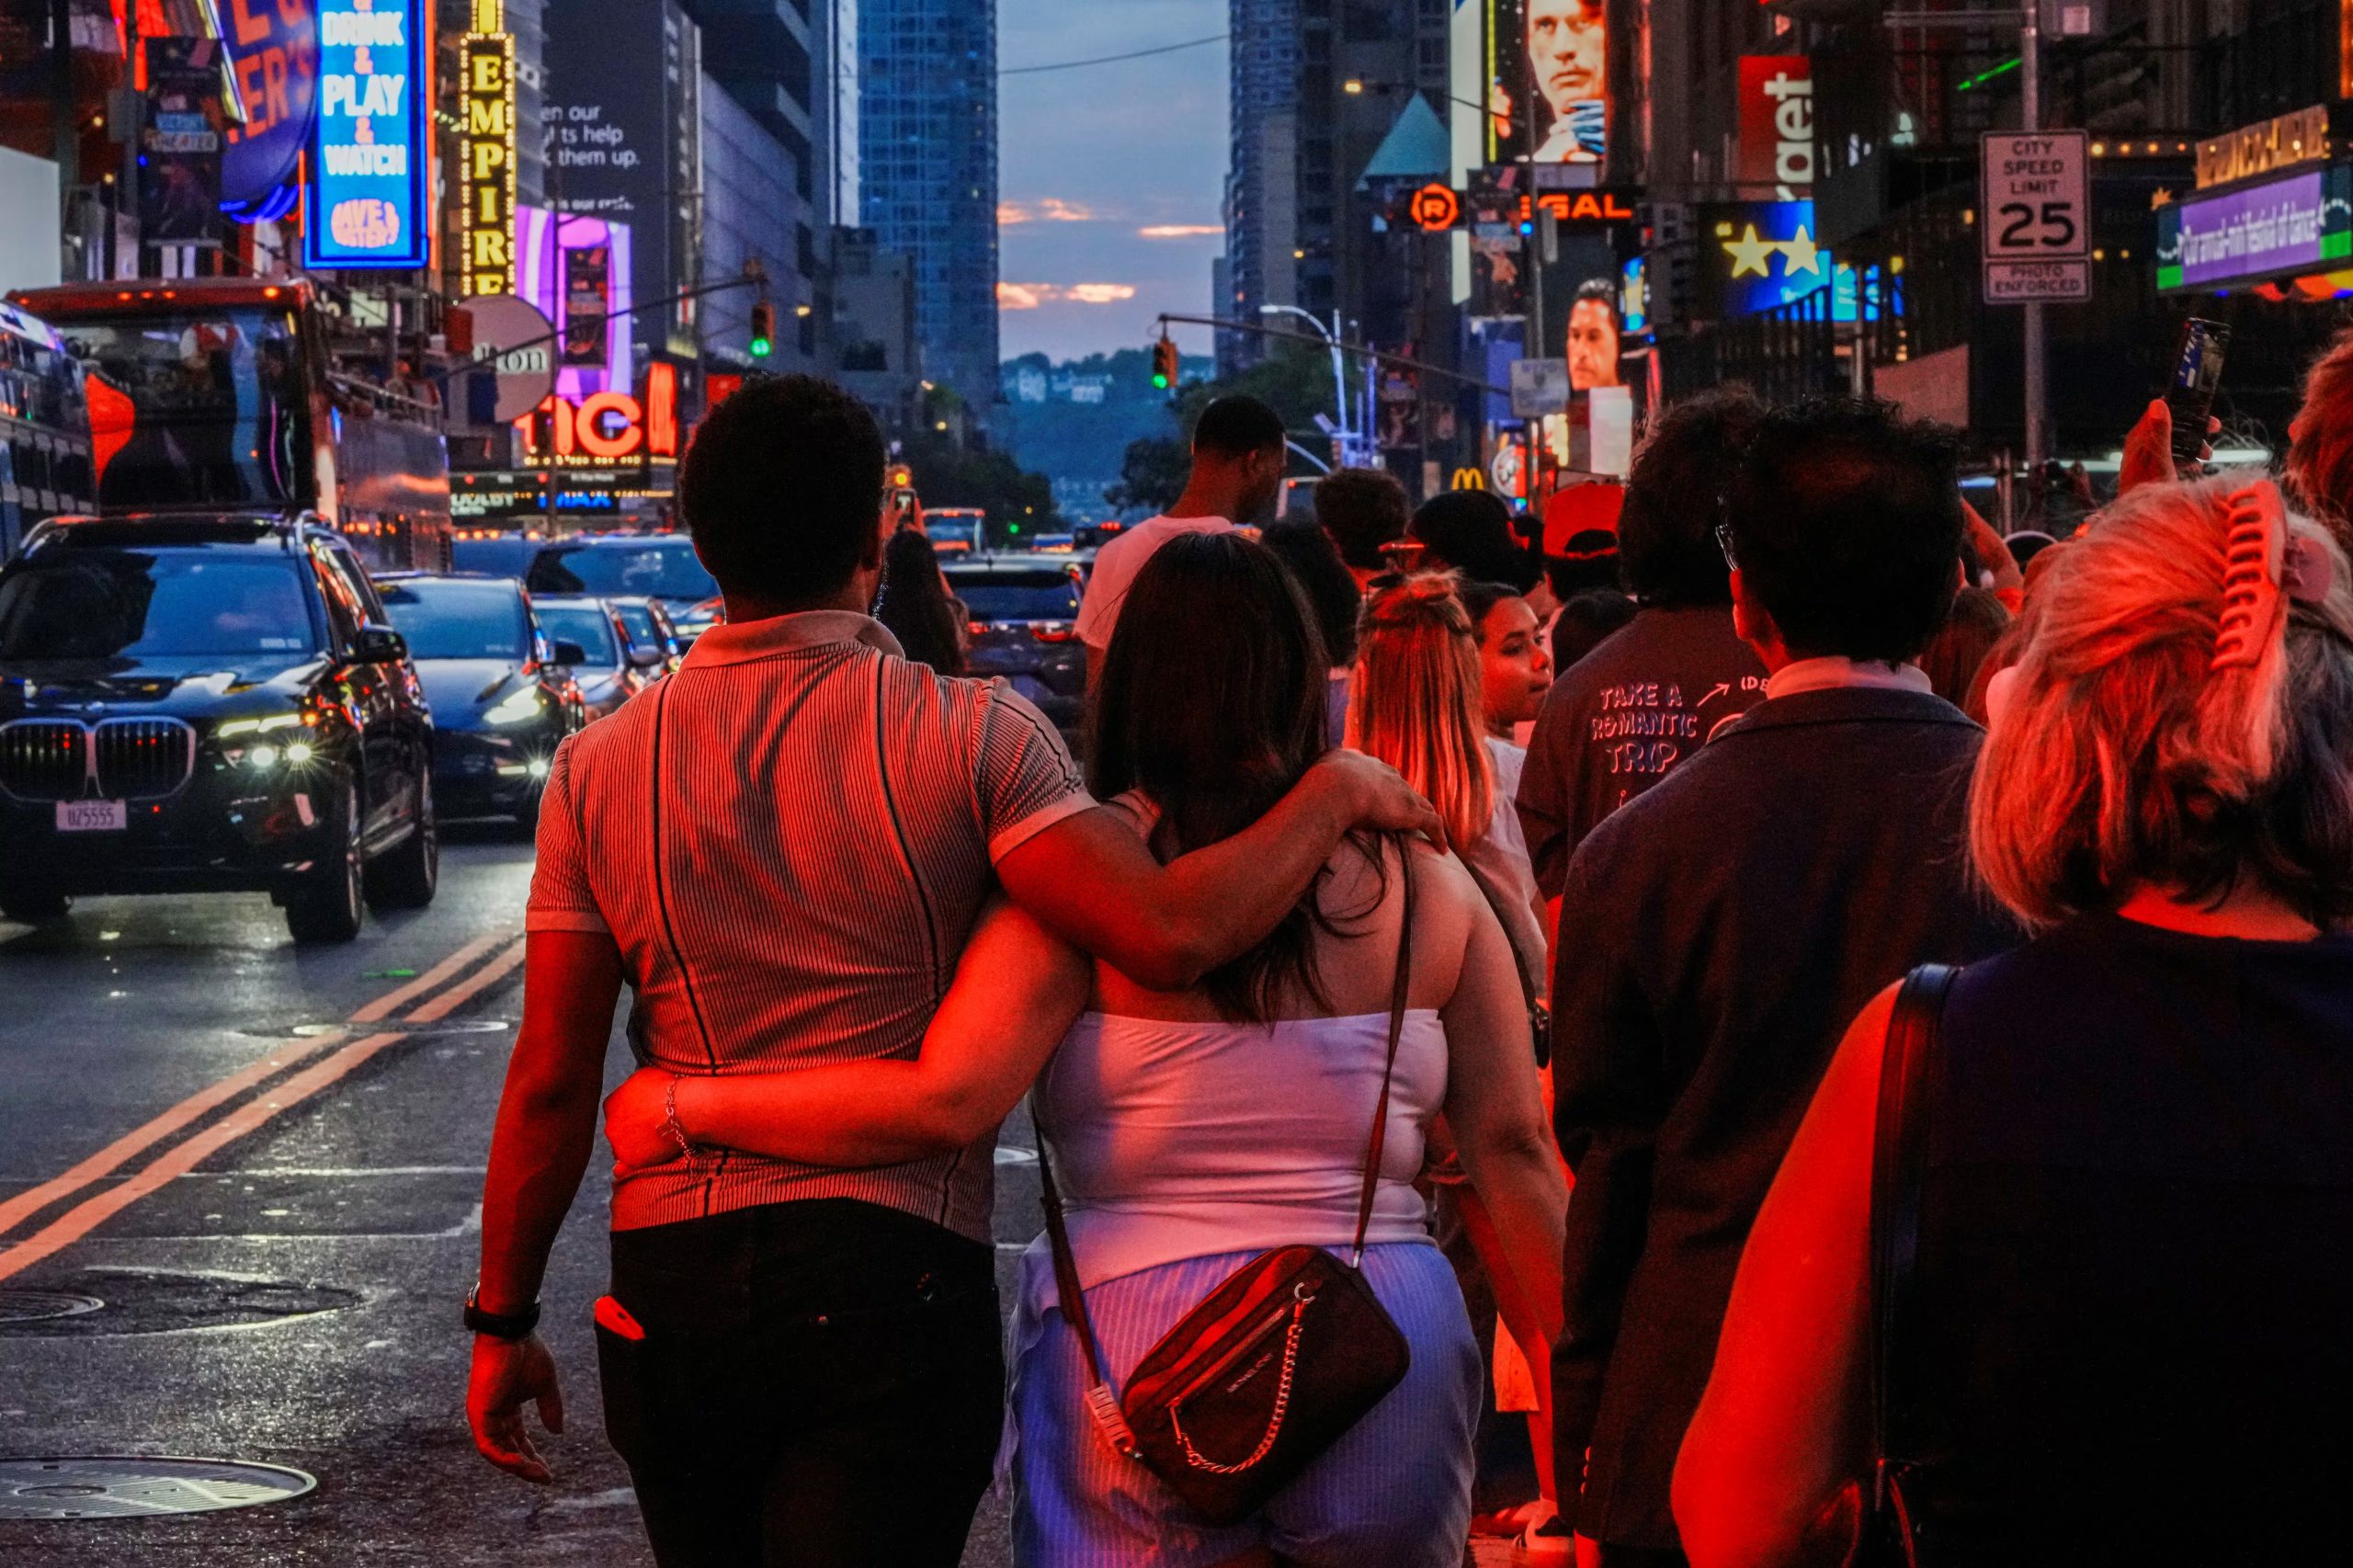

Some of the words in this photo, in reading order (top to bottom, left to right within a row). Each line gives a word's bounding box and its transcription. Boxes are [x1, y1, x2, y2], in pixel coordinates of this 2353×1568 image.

[322, 11, 404, 46] DRINK
[354, 46, 373, 74] &
[323, 74, 405, 117] PLAY
[569, 106, 601, 121] our
[355, 117, 374, 144] &
[584, 123, 624, 147] help
[324, 144, 407, 176] WATCH
[2012, 141, 2054, 156] CITY
[470, 55, 506, 295] EMPIRE
[2004, 160, 2064, 175] SPEED
[2010, 179, 2059, 195] LIMIT
[2000, 202, 2075, 246] 25
[2010, 265, 2064, 278] PHOTO
[1995, 278, 2080, 293] ENFORCED
[1600, 684, 1659, 710] TAKE
[1665, 685, 1683, 708] A
[1592, 711, 1699, 741] ROMANTIC
[1606, 742, 1678, 774] TRIP
